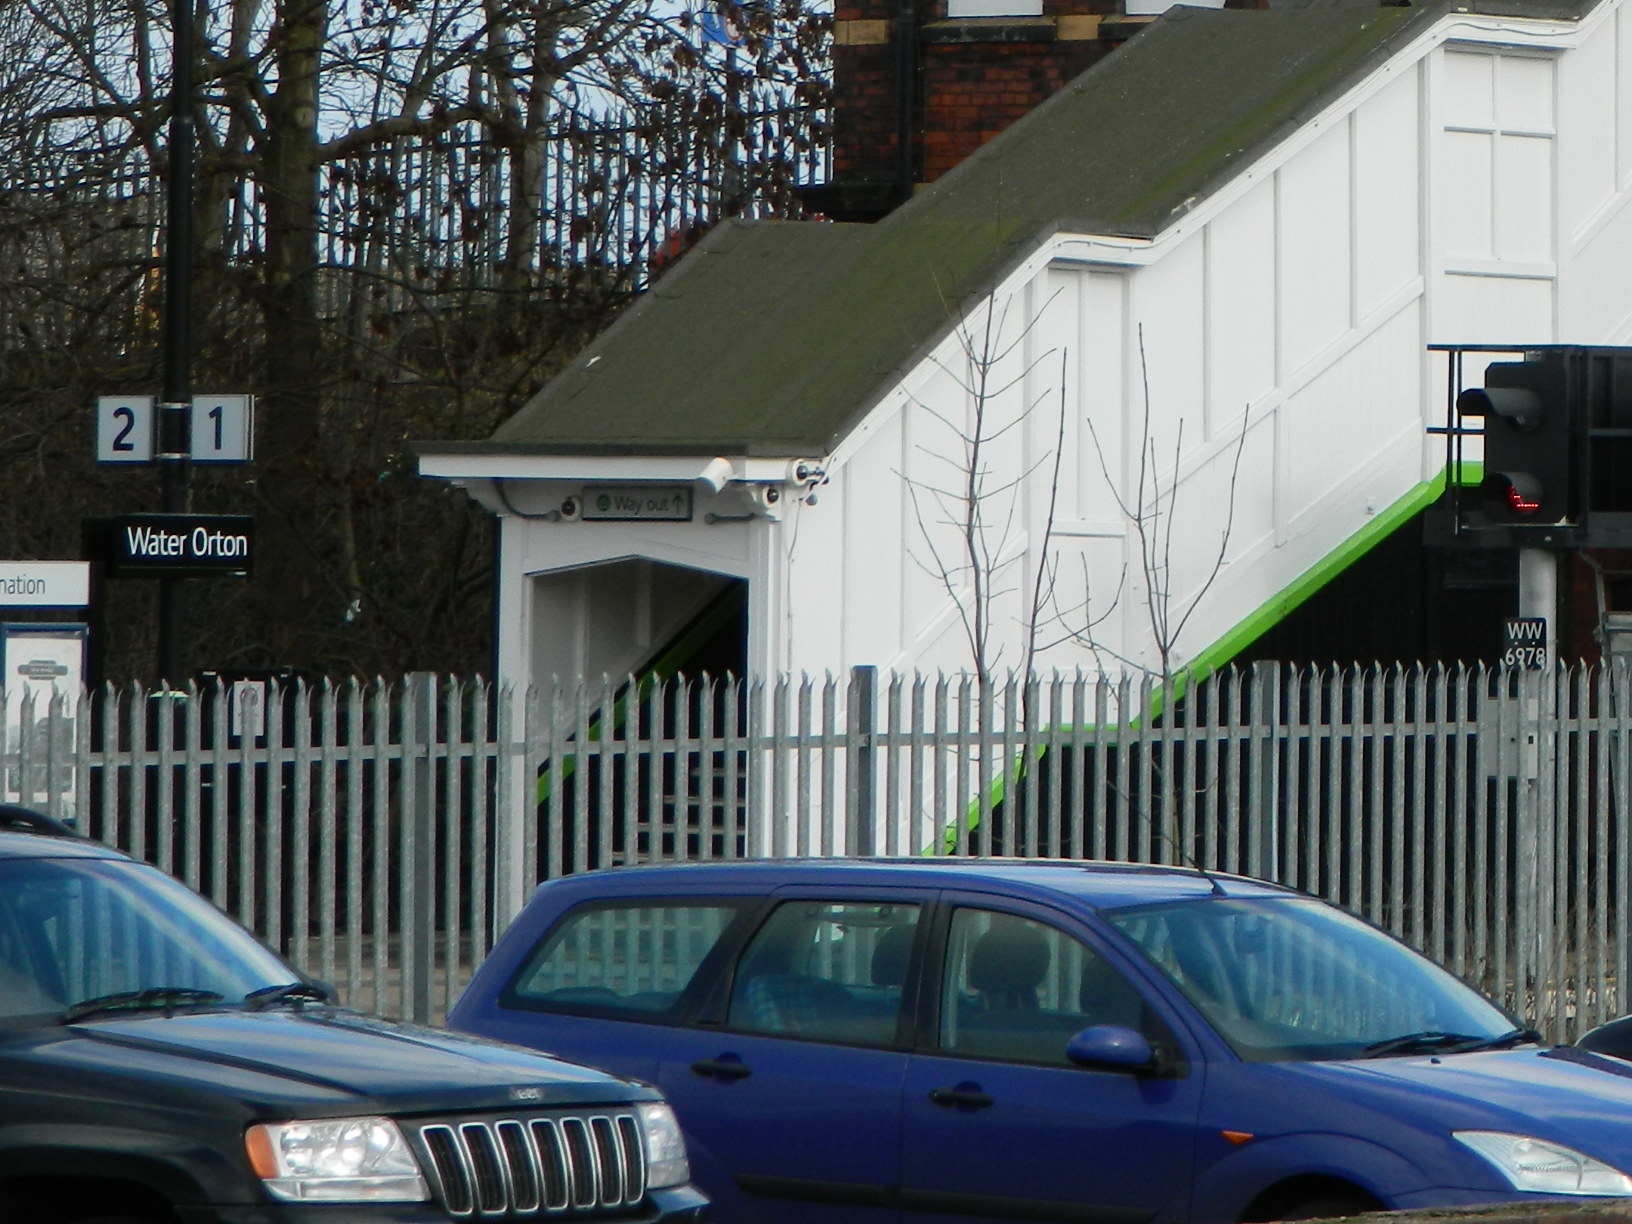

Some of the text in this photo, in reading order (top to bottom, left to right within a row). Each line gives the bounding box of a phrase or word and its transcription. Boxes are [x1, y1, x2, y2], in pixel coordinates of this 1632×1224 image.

[113, 407, 135, 451] 2
[208, 406, 222, 450] 1
[614, 496, 669, 515] Way out
[127, 526, 247, 556] Water Orton
[1507, 622, 1543, 640] WW
[1505, 647, 1546, 666] 6978
